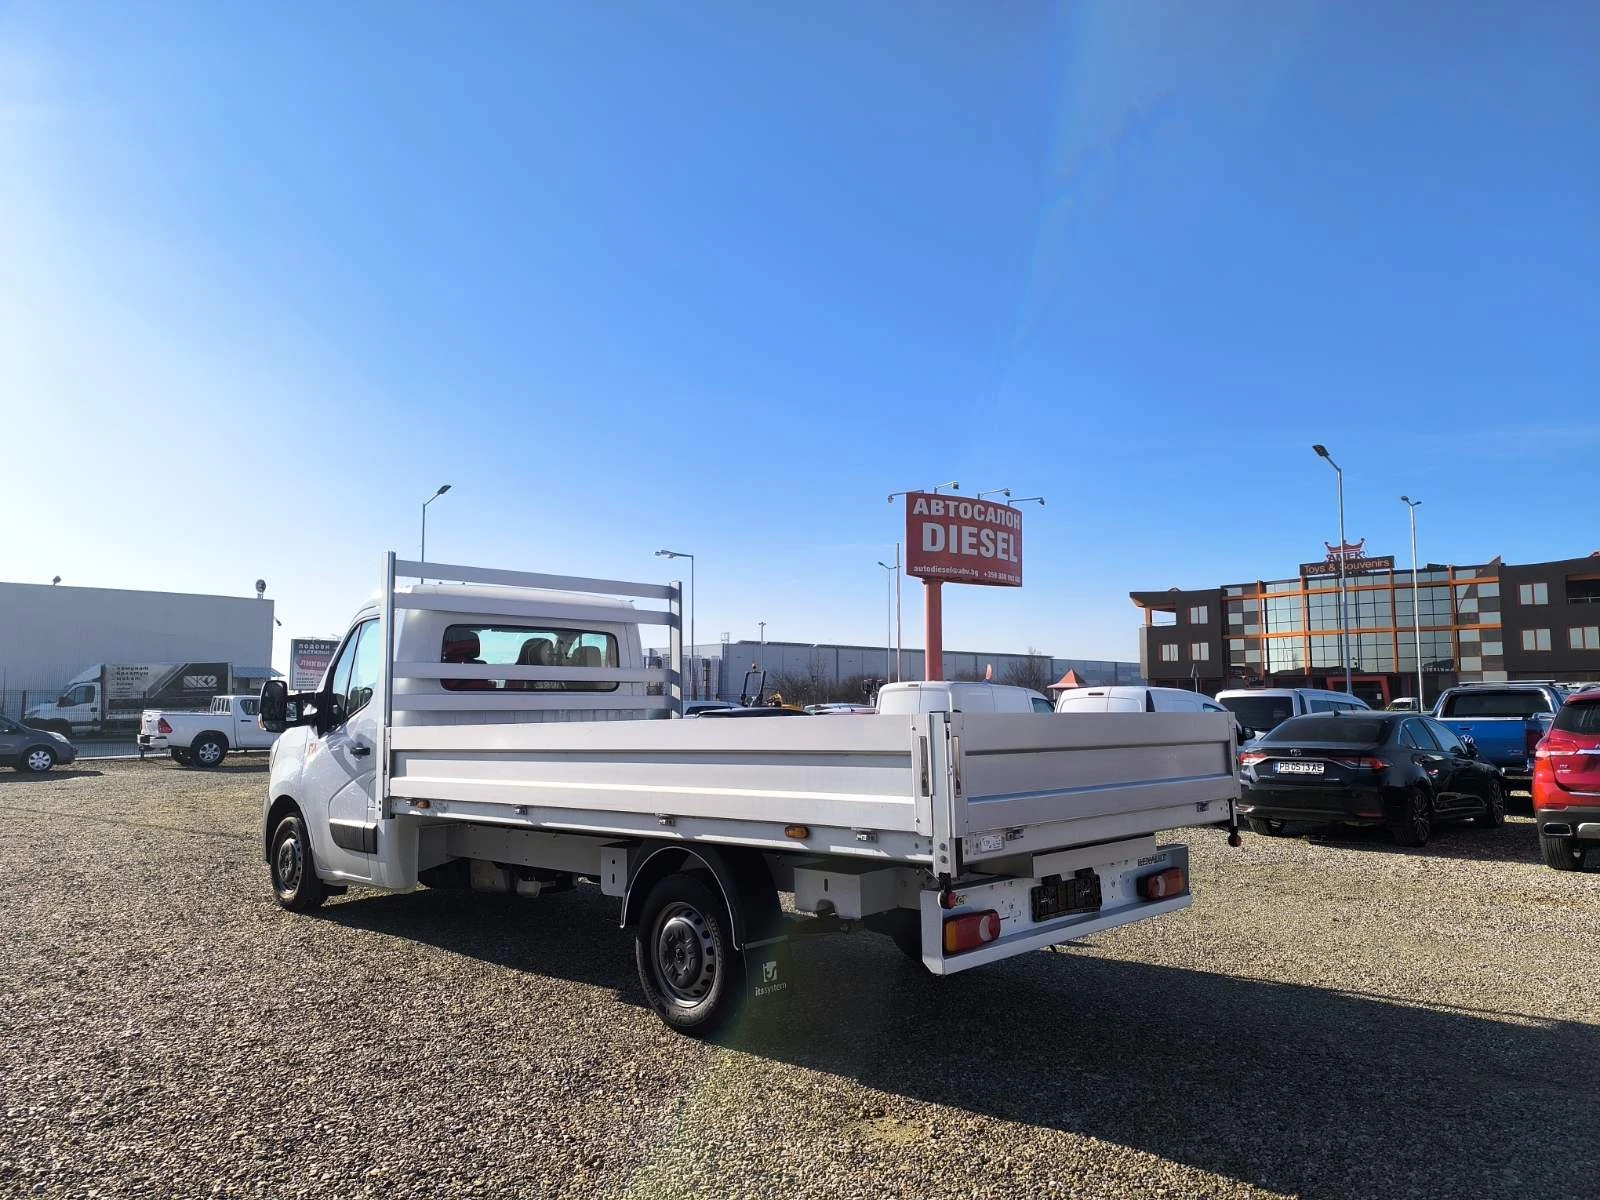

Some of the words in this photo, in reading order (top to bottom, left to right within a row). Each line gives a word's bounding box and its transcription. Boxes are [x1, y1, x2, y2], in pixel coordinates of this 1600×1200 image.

[913, 498, 1020, 529] АВТОСАЛОН
[922, 522, 1018, 563] DIESEL
[1303, 565, 1326, 574] Toys
[1328, 562, 1336, 572] &
[299, 659, 330, 668] ЛИКВИ
[1291, 762, 1311, 772] 0513
[1311, 763, 1323, 772] AE
